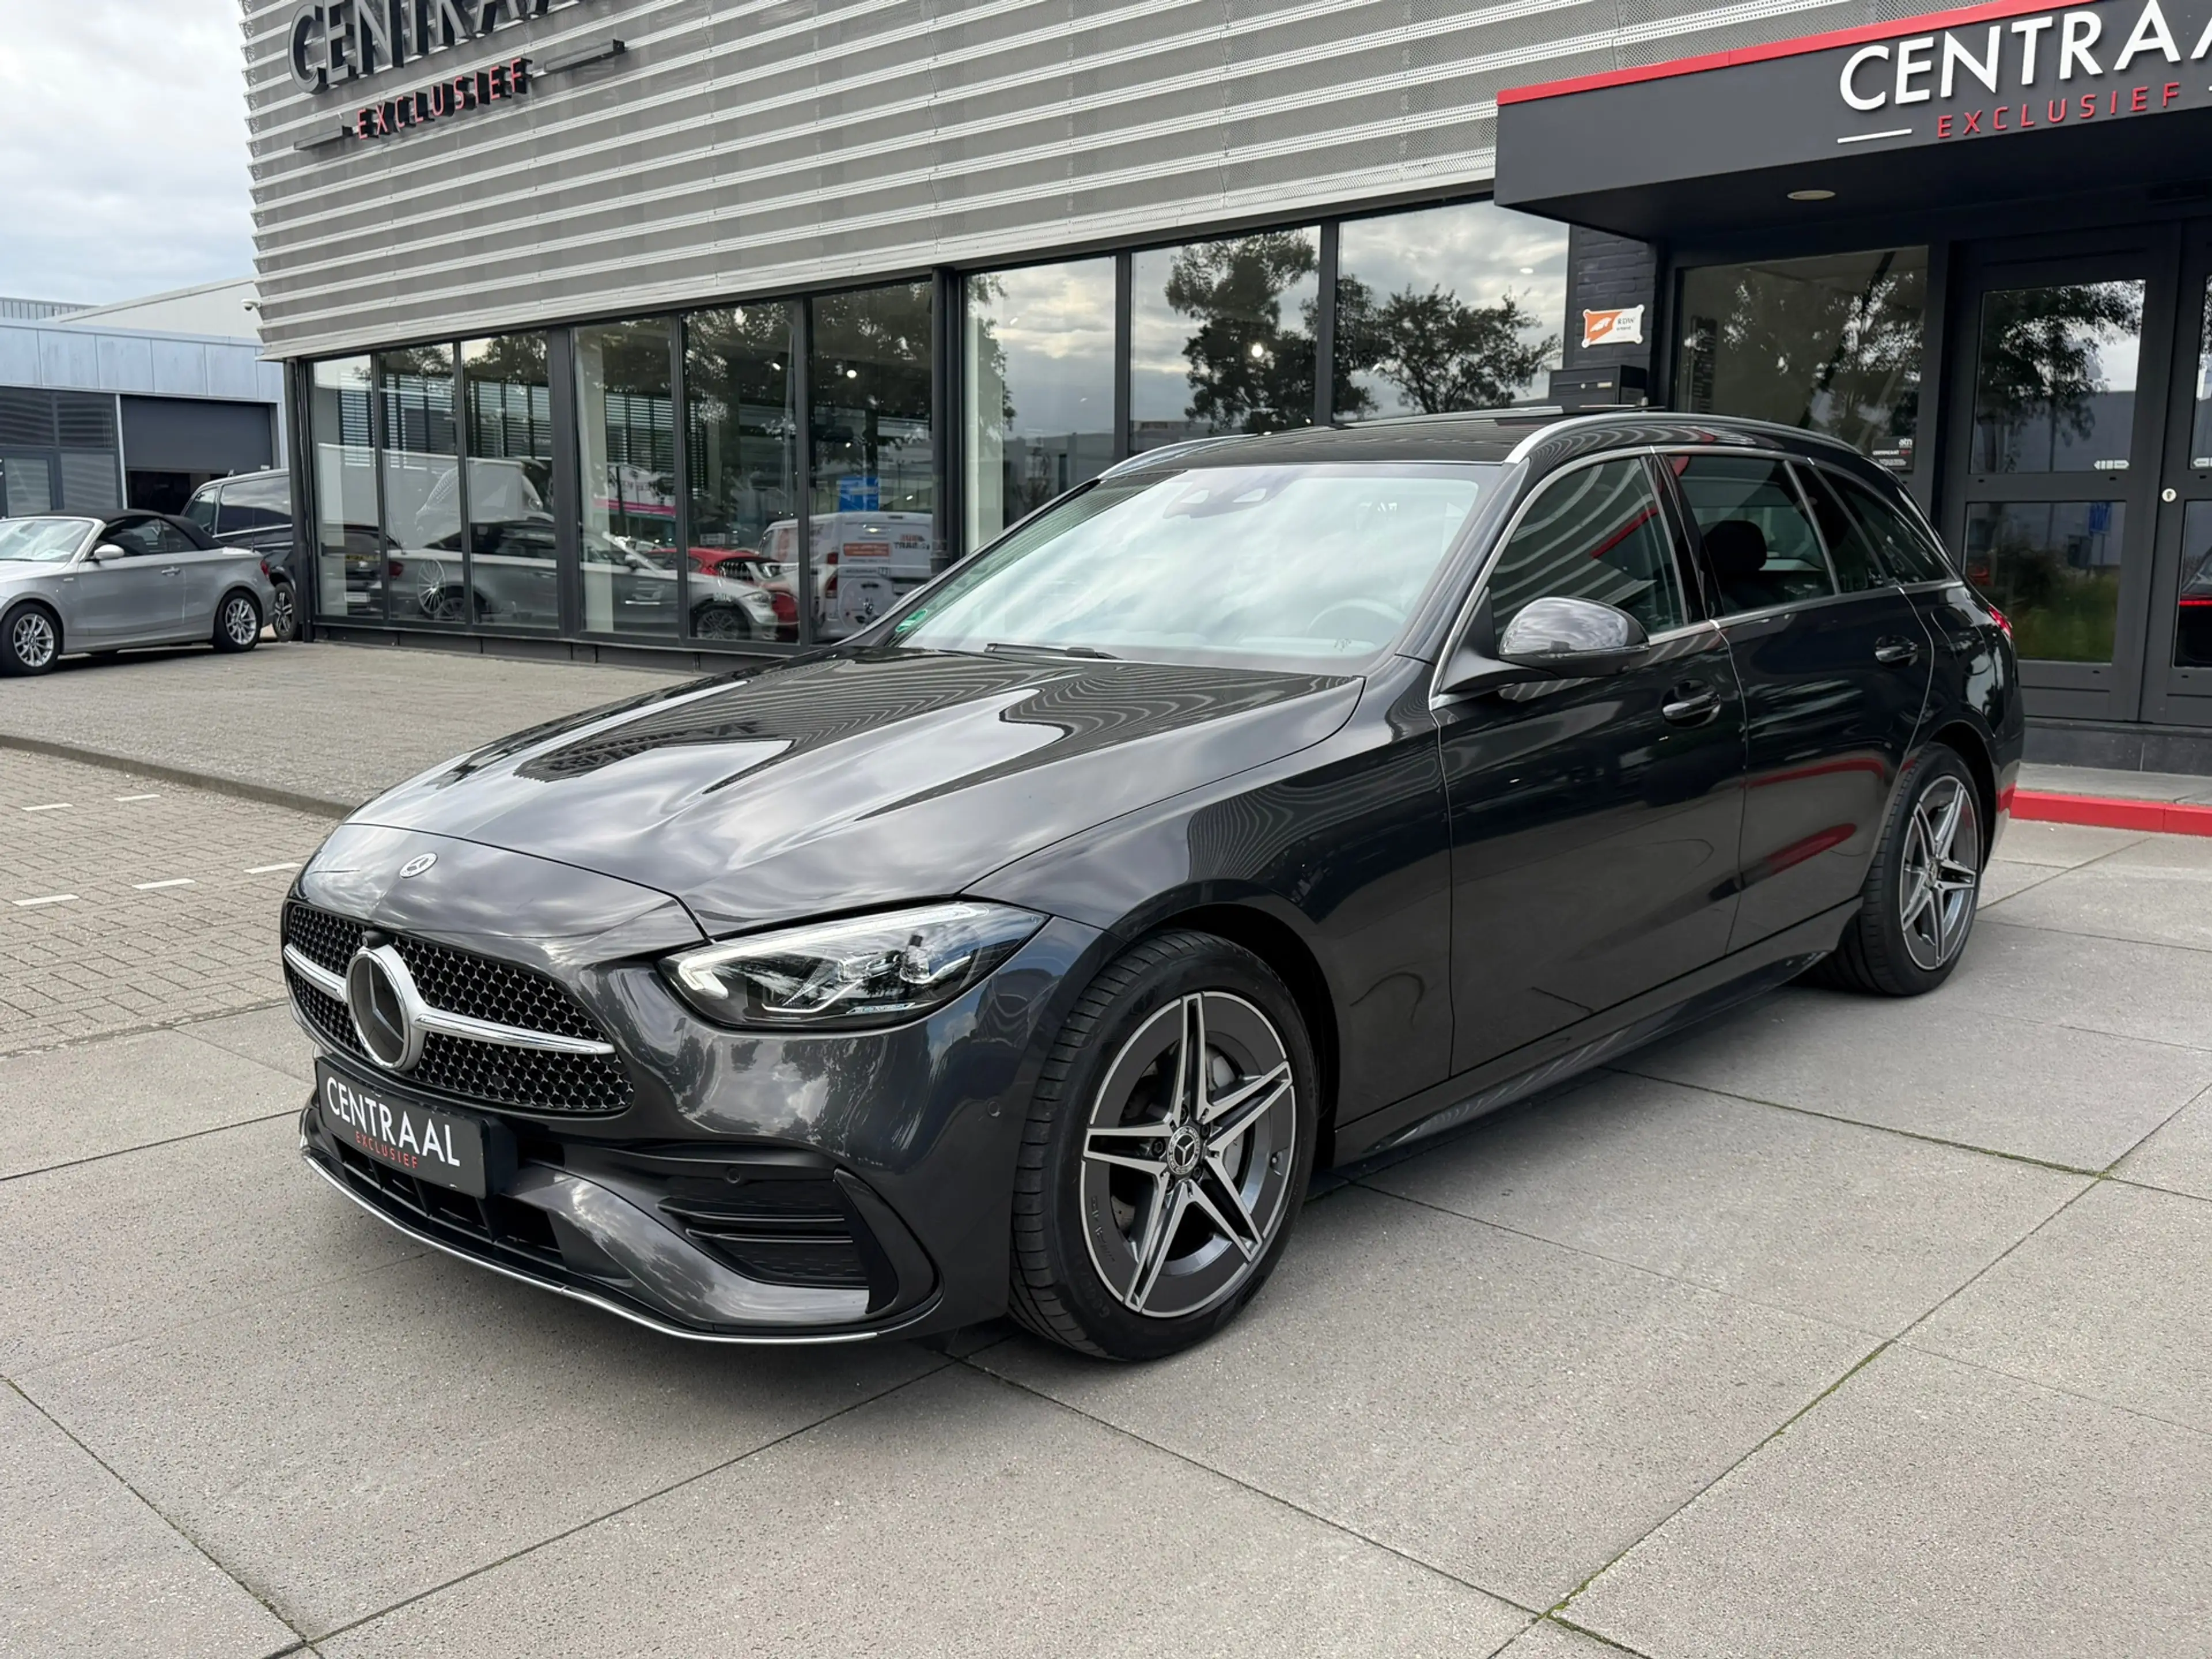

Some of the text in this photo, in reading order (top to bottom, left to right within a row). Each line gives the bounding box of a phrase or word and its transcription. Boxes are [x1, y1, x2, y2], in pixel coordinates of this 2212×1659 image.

[356, 58, 529, 139] EXCLUSIEF
[1937, 82, 2180, 138] EXCLUSIEF
[327, 1076, 460, 1167] CENTRAAL
[355, 1131, 418, 1169] EXCLUSIEF
